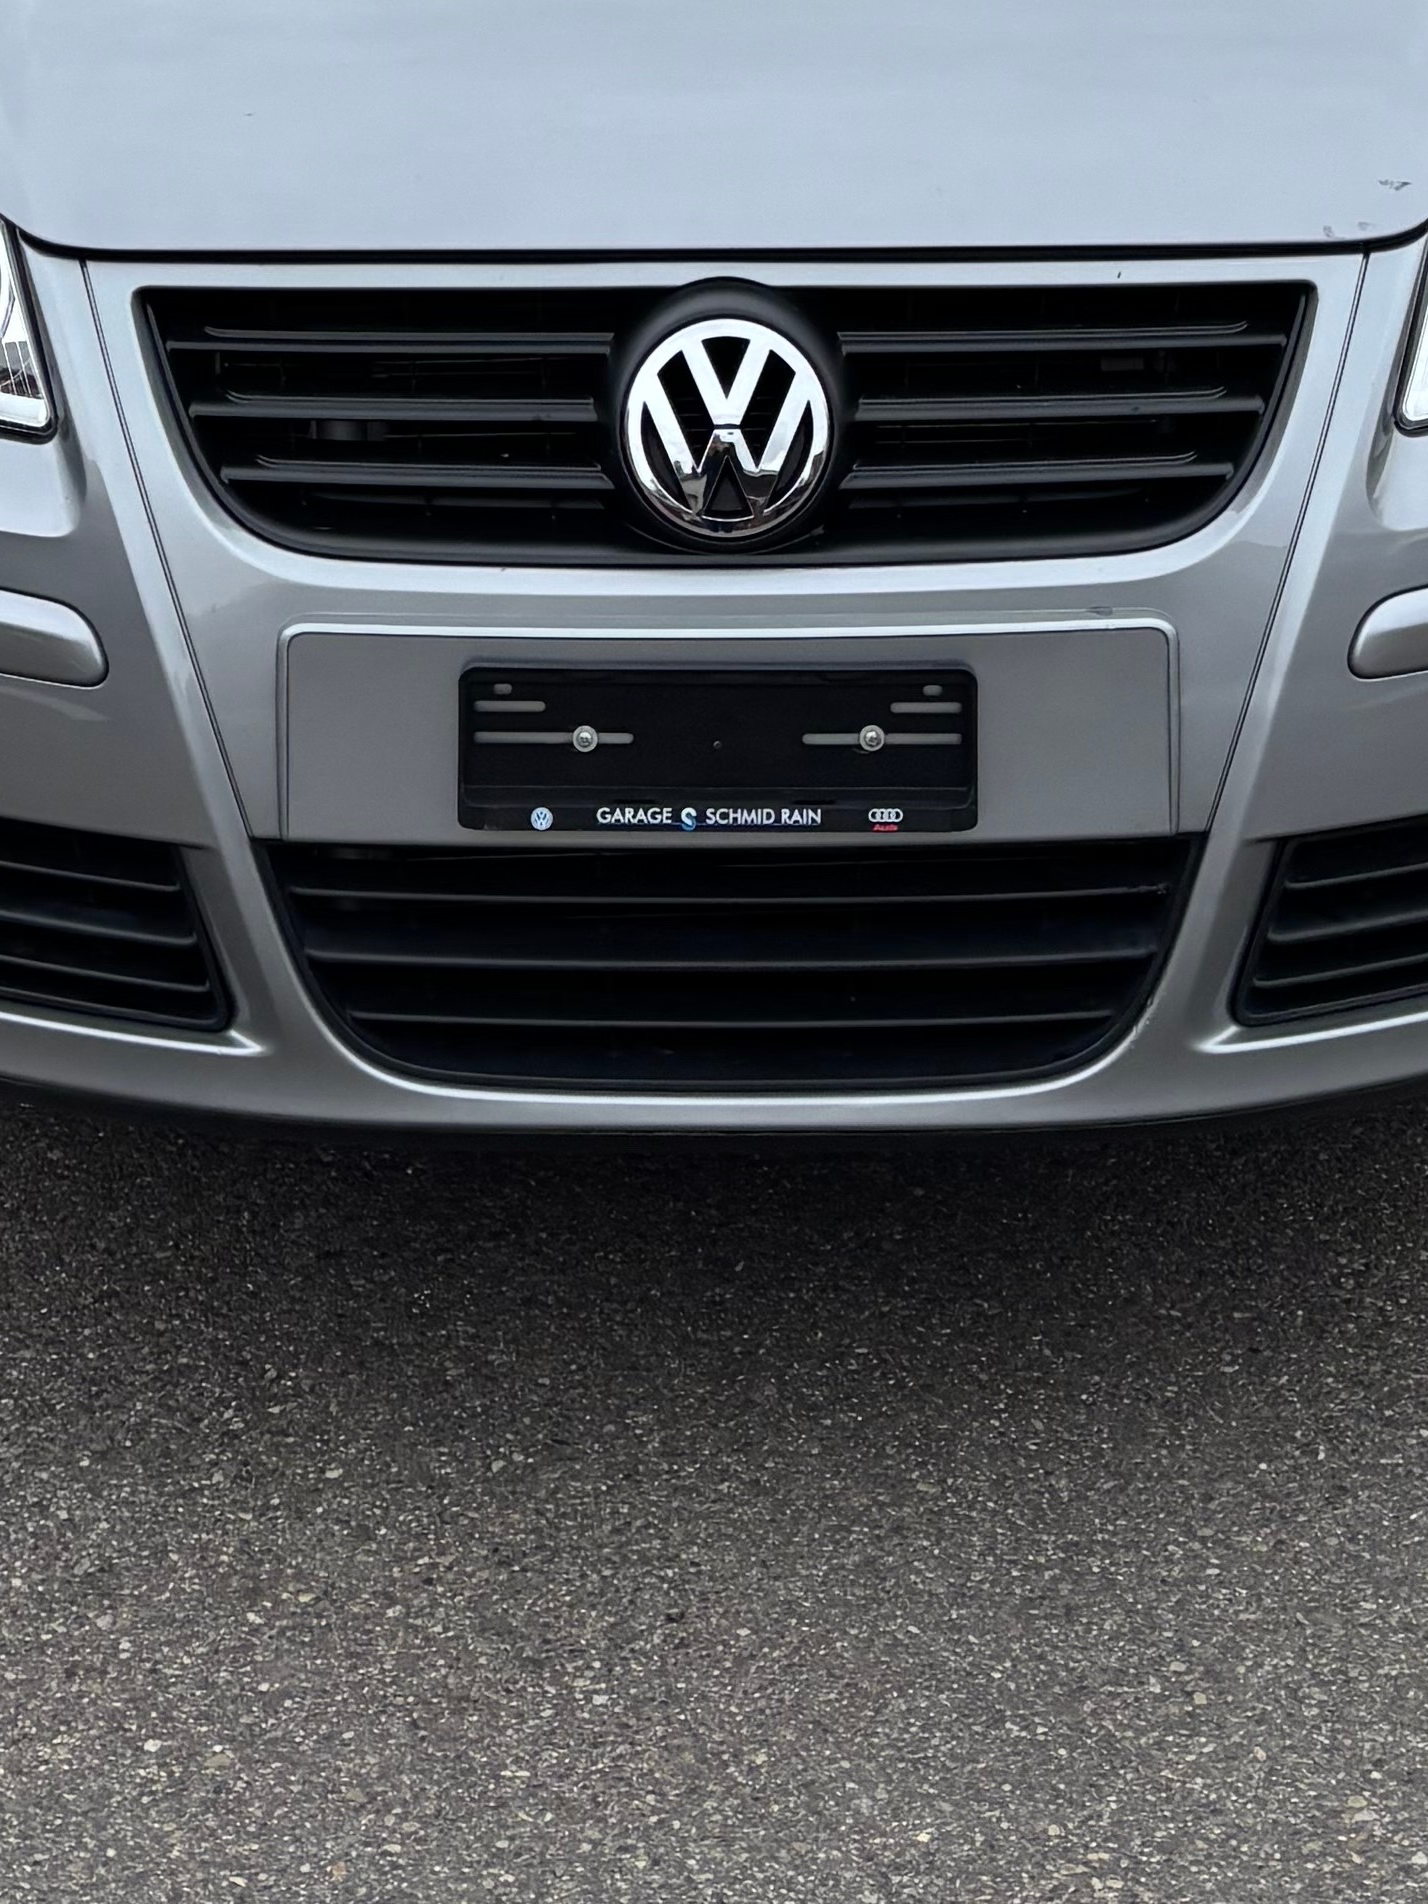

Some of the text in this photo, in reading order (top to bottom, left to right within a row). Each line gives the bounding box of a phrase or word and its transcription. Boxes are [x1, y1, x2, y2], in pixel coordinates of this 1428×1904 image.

[596, 807, 673, 824] GARAGE
[705, 808, 775, 825] SCHMID
[781, 808, 822, 825] RAIN
